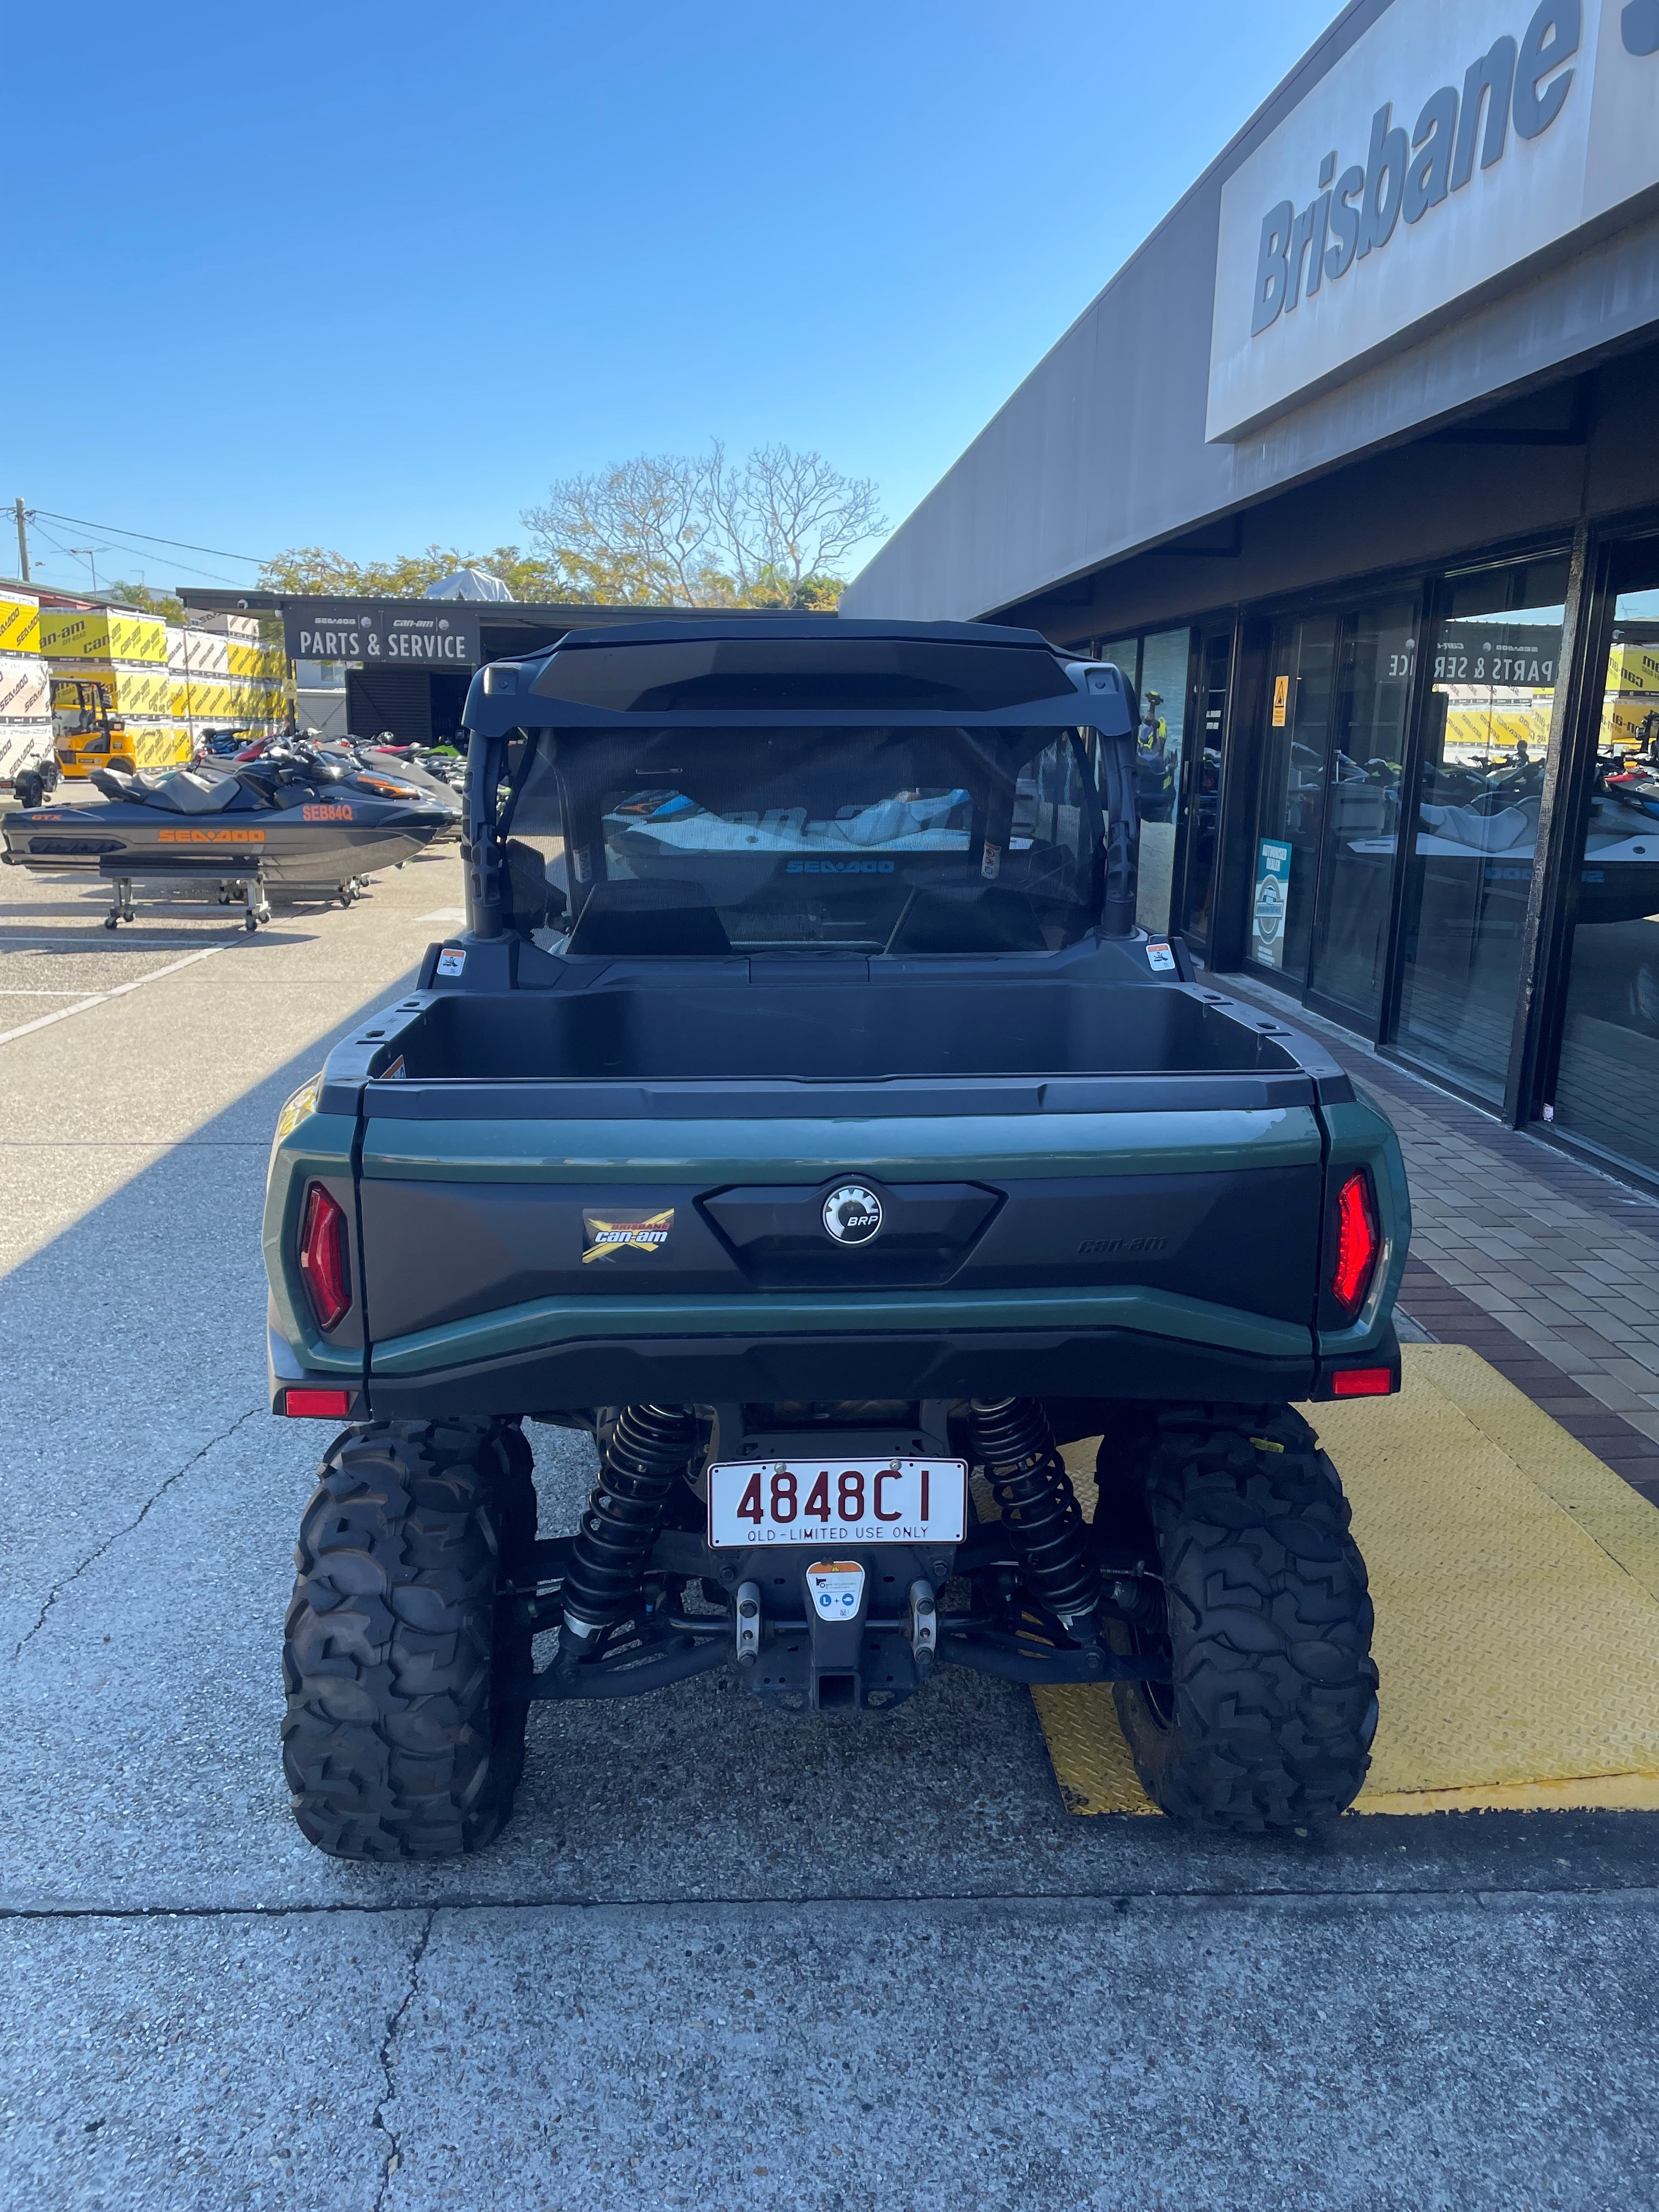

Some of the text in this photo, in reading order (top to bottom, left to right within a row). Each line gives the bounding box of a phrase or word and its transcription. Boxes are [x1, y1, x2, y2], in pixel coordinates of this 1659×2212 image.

[1251, 0, 1583, 337] Brisbane
[300, 631, 465, 658] PARTS & SERVICE
[302, 804, 353, 821] SEB84Q
[611, 1222, 670, 1231] BRISBANE
[847, 1215, 878, 1226] BRP
[595, 1231, 668, 1243] can-am
[856, 1527, 883, 1538] USE
[893, 1526, 929, 1538] ONLY
